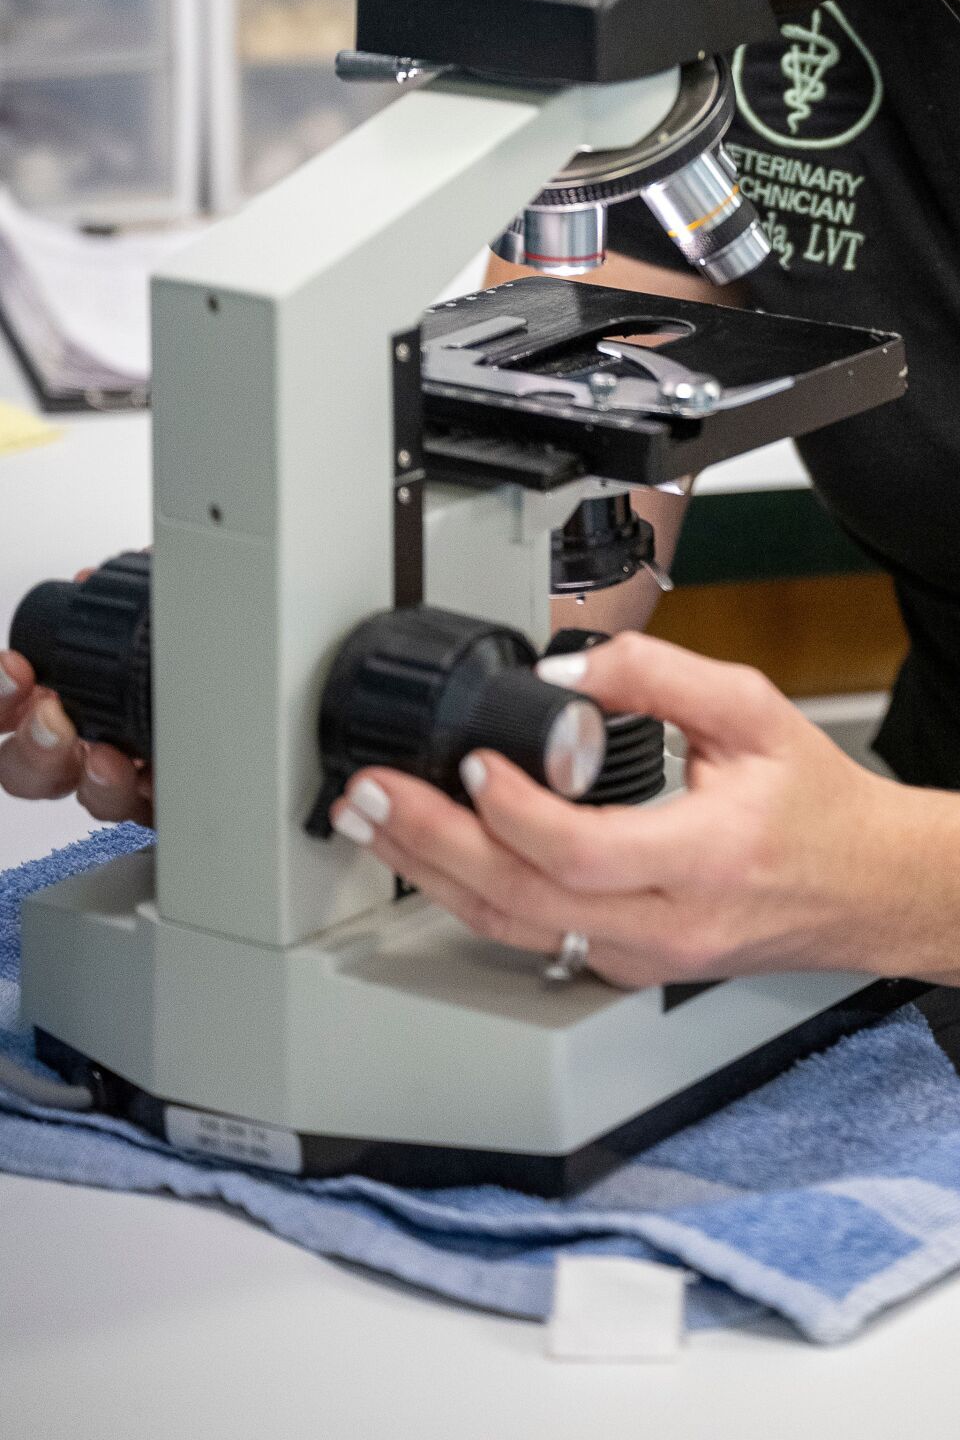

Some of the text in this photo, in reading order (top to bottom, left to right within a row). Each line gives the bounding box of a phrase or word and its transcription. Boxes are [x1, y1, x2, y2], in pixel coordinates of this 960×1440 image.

[725, 142, 865, 197] ETERINARY
[738, 175, 856, 225] CHNICIAN
[803, 223, 865, 271] LVT
